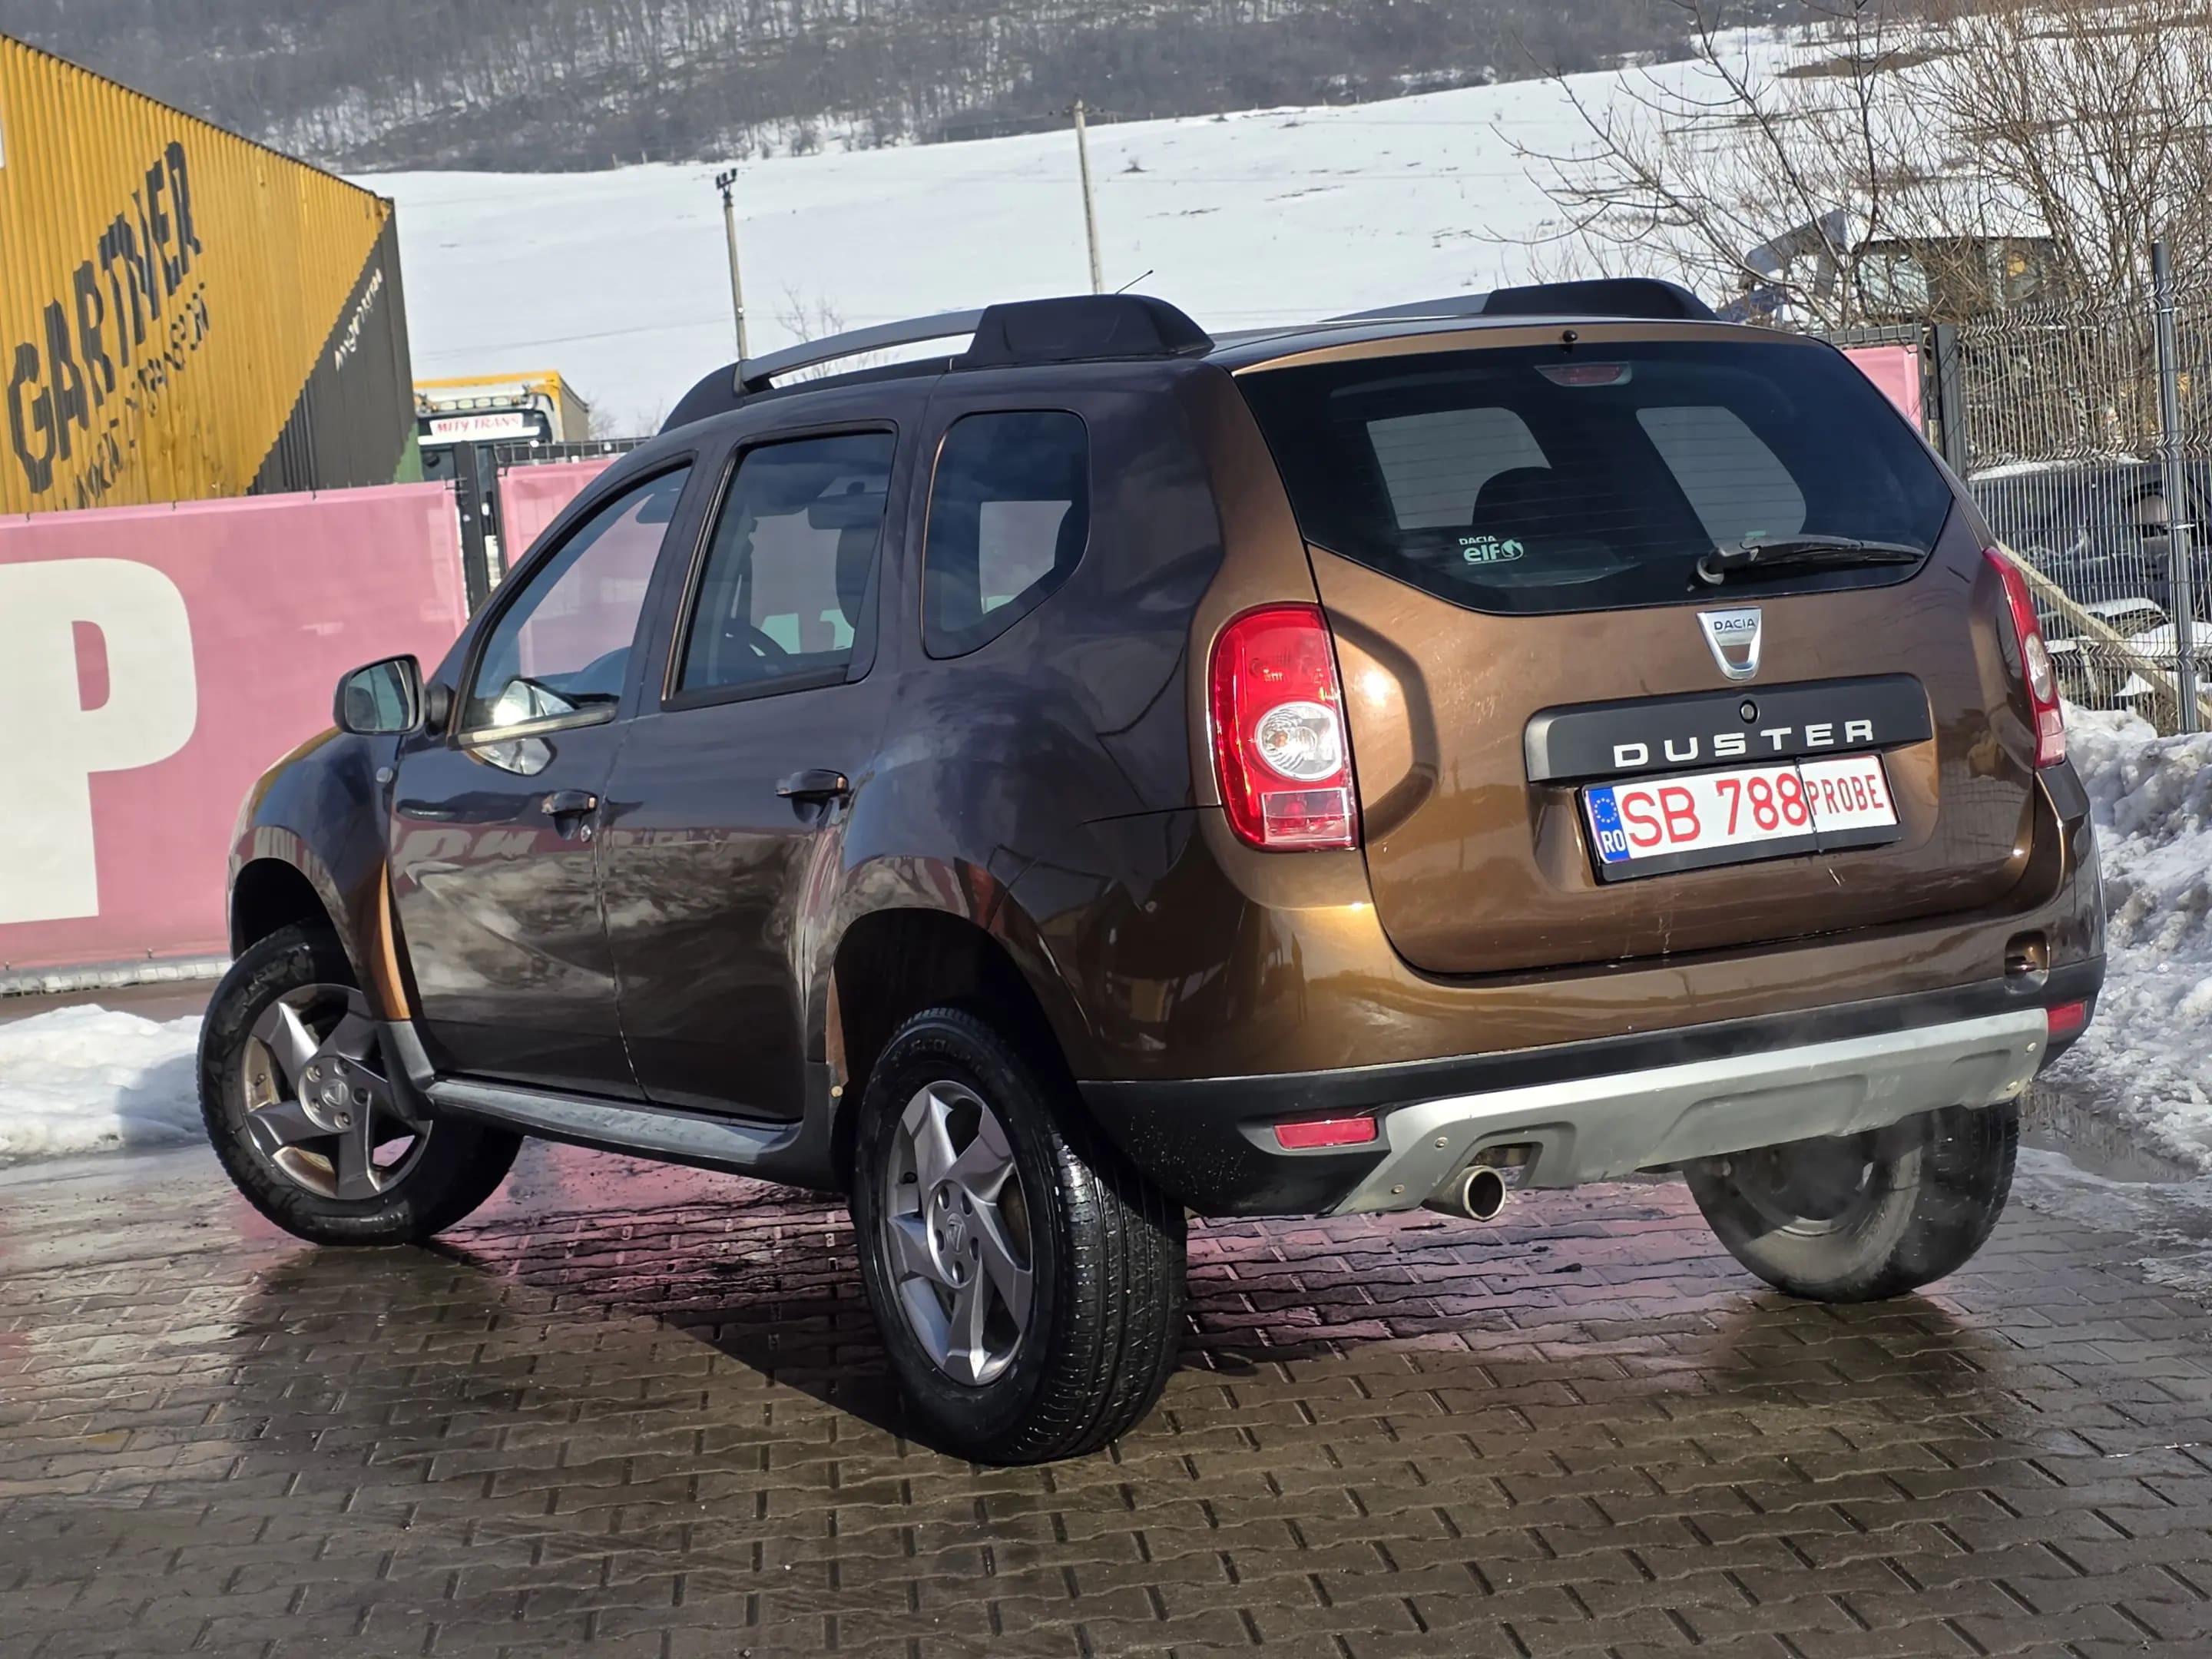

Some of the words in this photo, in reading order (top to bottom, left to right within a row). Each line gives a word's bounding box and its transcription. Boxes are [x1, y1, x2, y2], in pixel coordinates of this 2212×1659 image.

[7, 141, 203, 494] GARTNER
[473, 416, 519, 429] TRANS
[1459, 535, 1497, 545] DACIA
[1464, 543, 1500, 561] elf
[1714, 618, 1756, 630] DACIA
[1614, 720, 1874, 767] DUSTER
[1621, 786, 1700, 848] SB
[1715, 773, 1808, 836] 788
[1806, 774, 1884, 816] PROBE
[1600, 830, 1627, 853] RO
